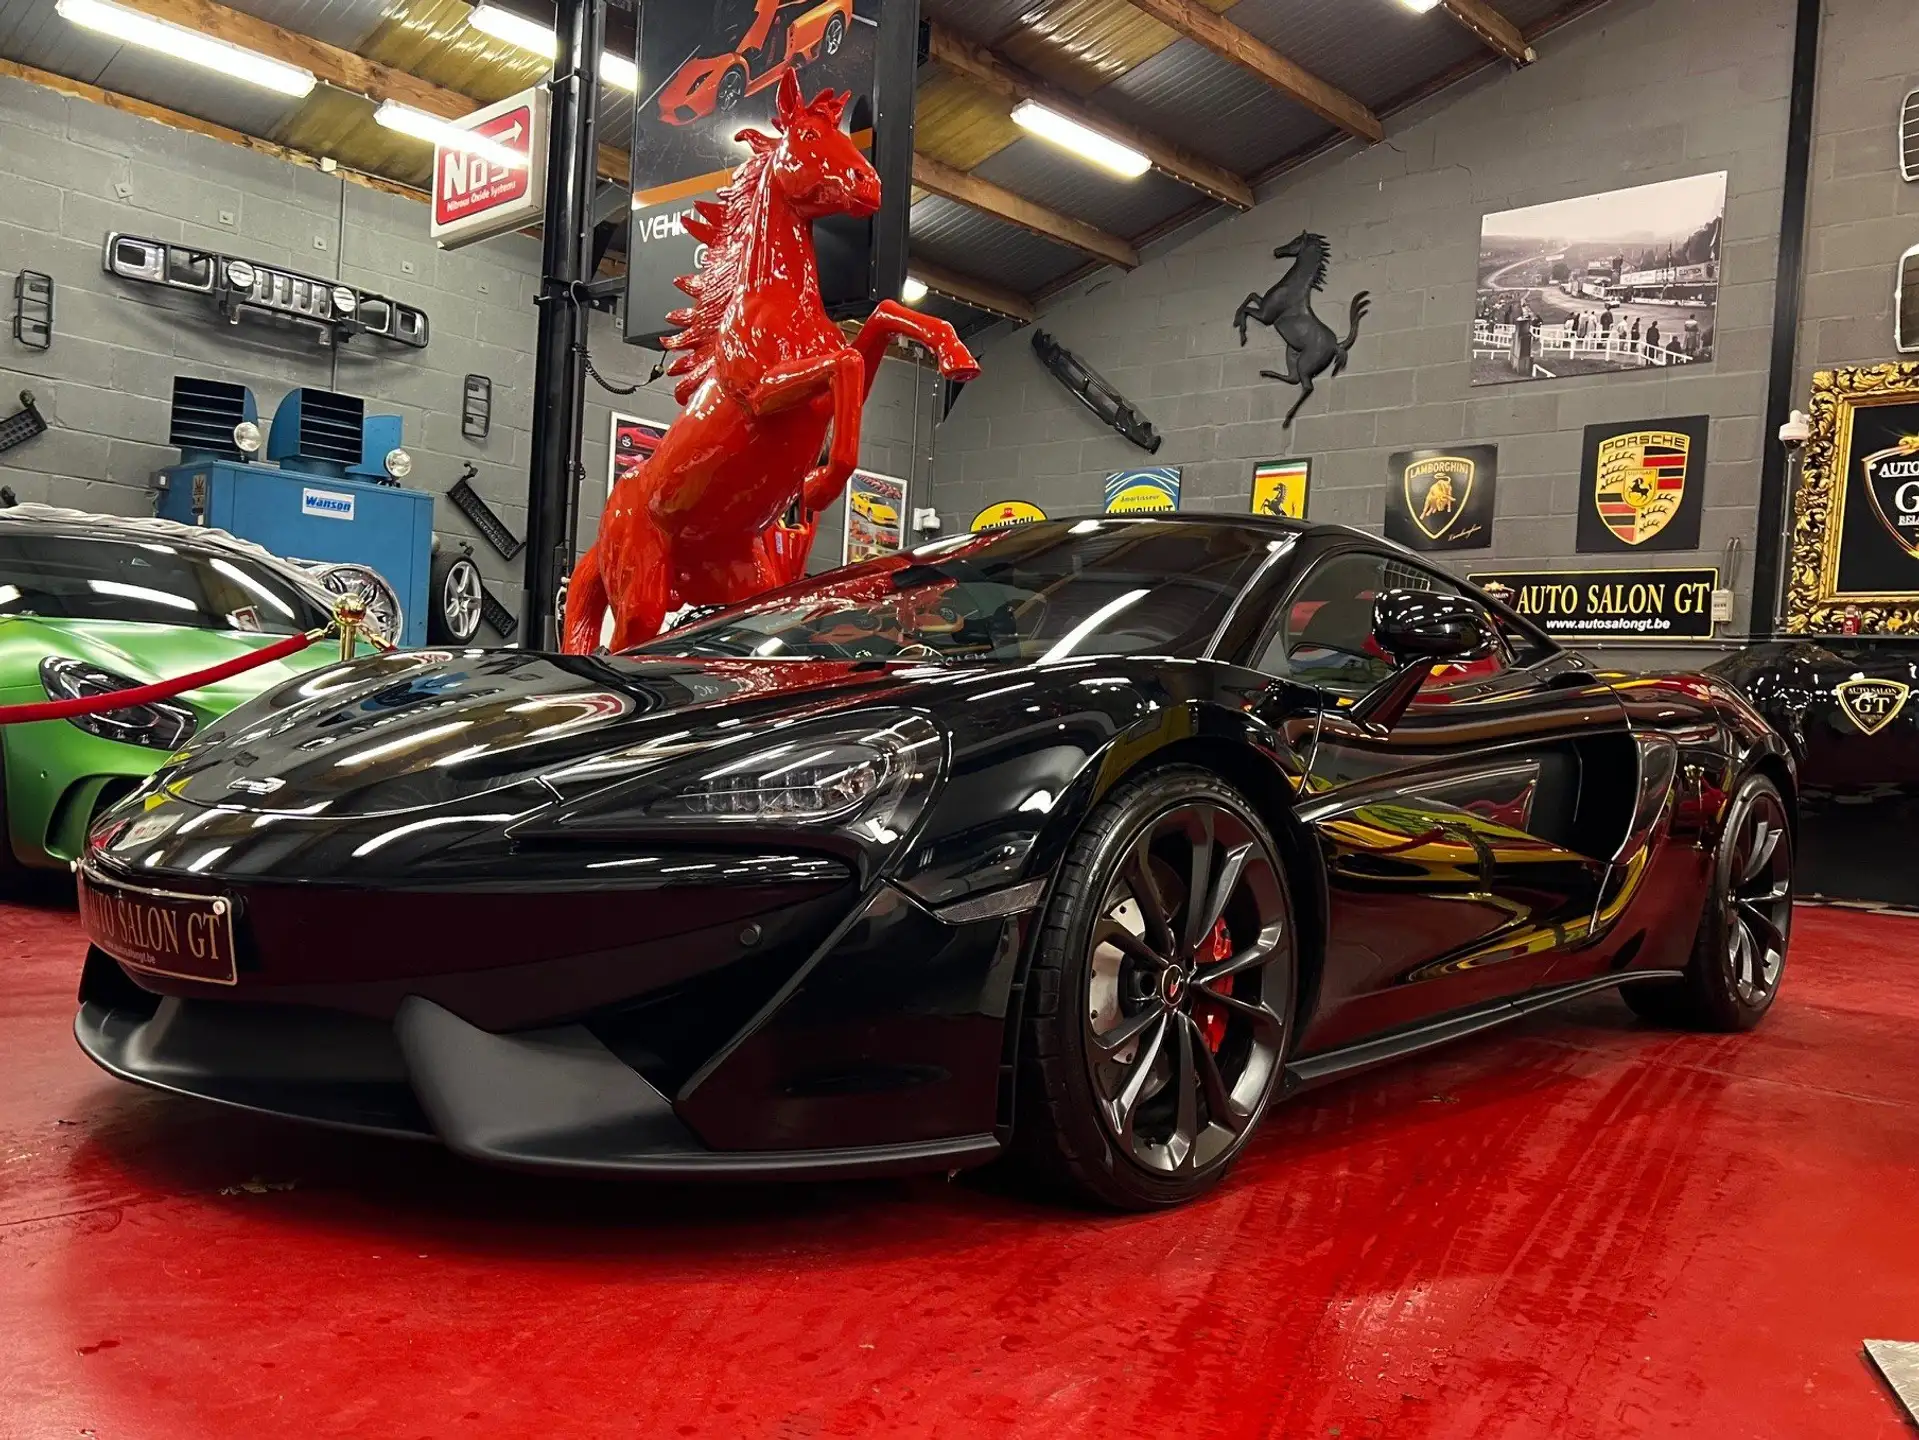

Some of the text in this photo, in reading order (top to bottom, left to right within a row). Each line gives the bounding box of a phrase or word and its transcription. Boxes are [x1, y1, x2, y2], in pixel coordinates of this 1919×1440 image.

[471, 188, 491, 203] Oxide
[490, 181, 517, 197] Systems
[1602, 434, 1686, 454] PORSCHE
[1410, 460, 1470, 479] LAMBORGHINI
[305, 495, 352, 512] Wanson
[1515, 582, 1711, 615] AUTO SALON GT
[1545, 617, 1672, 632] www.autosalongt.be
[1848, 687, 1898, 696] AUTO SALON
[1855, 696, 1890, 714] GT
[117, 899, 180, 955] SALON
[187, 911, 221, 960] GT
